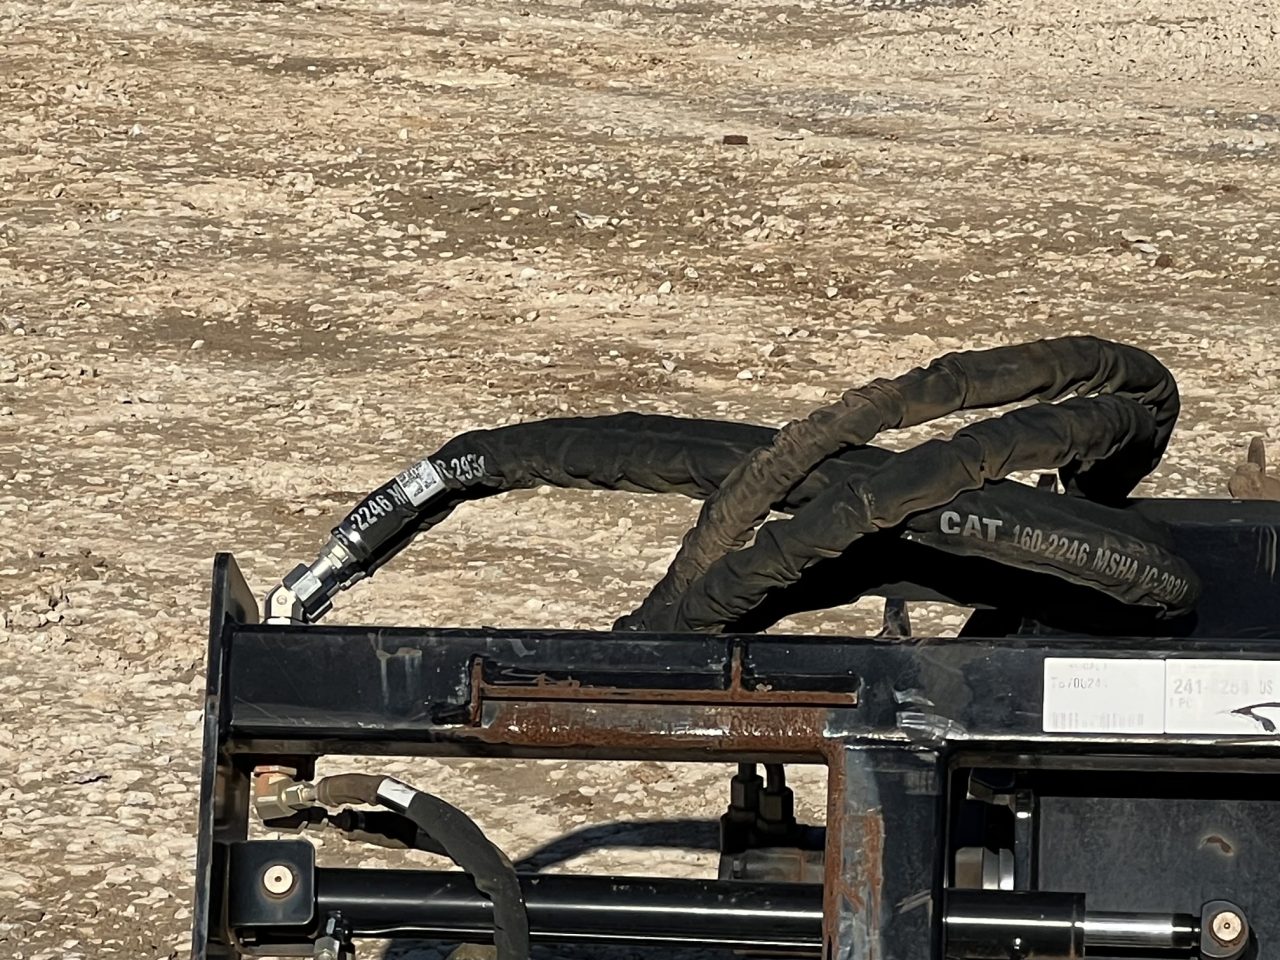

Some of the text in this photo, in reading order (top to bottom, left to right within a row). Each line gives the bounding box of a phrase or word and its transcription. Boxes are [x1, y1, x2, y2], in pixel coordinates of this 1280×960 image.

[940, 510, 1002, 542] CAT
[1013, 525, 1090, 567] 160-2246
[1092, 548, 1138, 583] MSHA
